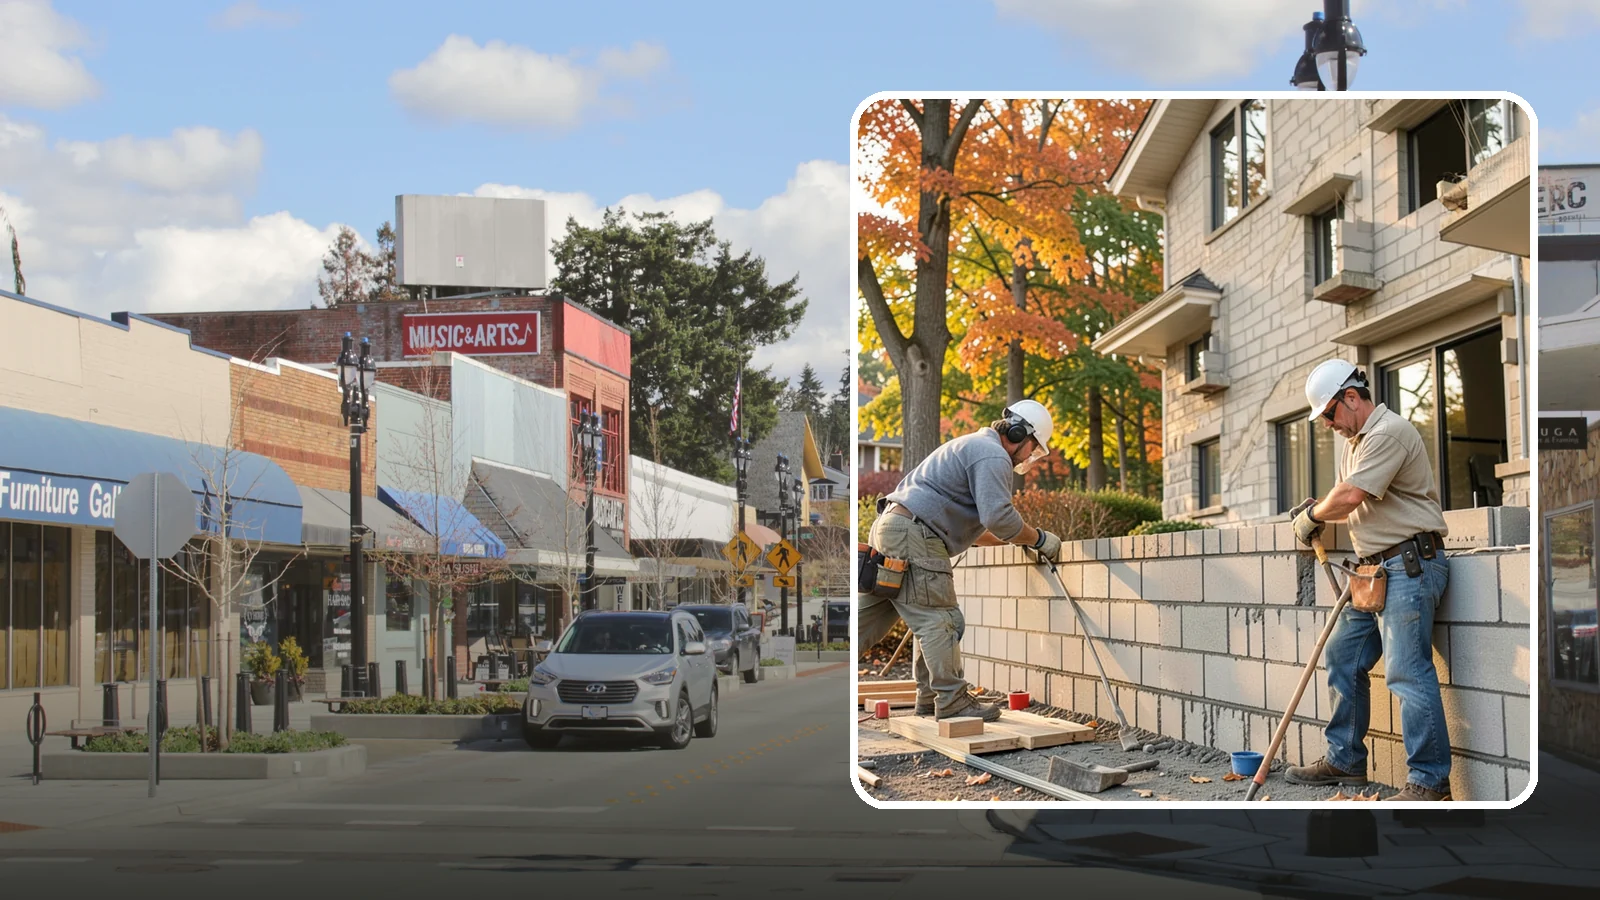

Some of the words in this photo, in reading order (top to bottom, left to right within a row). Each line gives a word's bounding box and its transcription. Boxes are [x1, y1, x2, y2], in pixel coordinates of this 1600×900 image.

[409, 323, 519, 348] MUSIC&ARTS
[0, 471, 79, 515] Furniture
[89, 482, 122, 519] Gal
